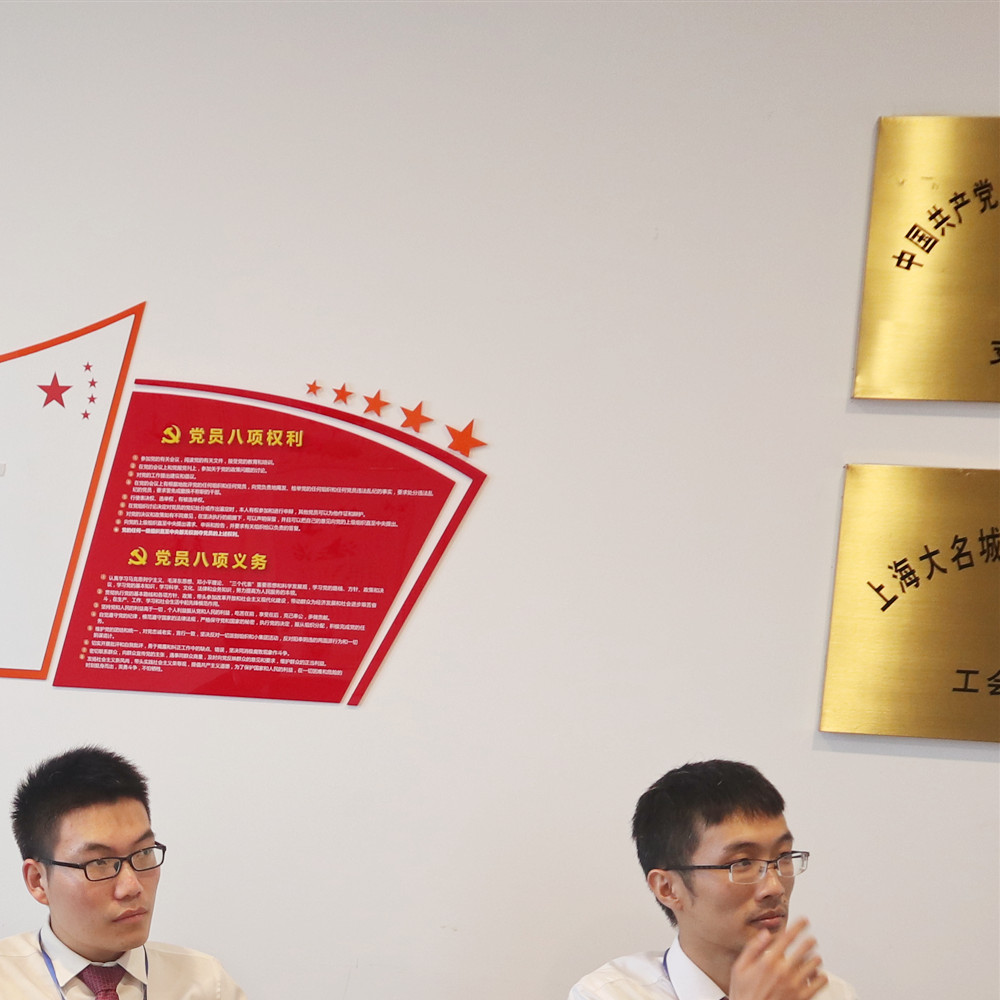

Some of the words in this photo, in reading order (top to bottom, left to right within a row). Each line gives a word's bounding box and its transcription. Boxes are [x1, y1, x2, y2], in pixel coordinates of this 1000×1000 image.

[891, 178, 998, 271] 中国共产党
[188, 427, 305, 448] 党员八项权利
[154, 549, 269, 571] 党员八项义务
[867, 526, 1000, 612] 上海大名城
